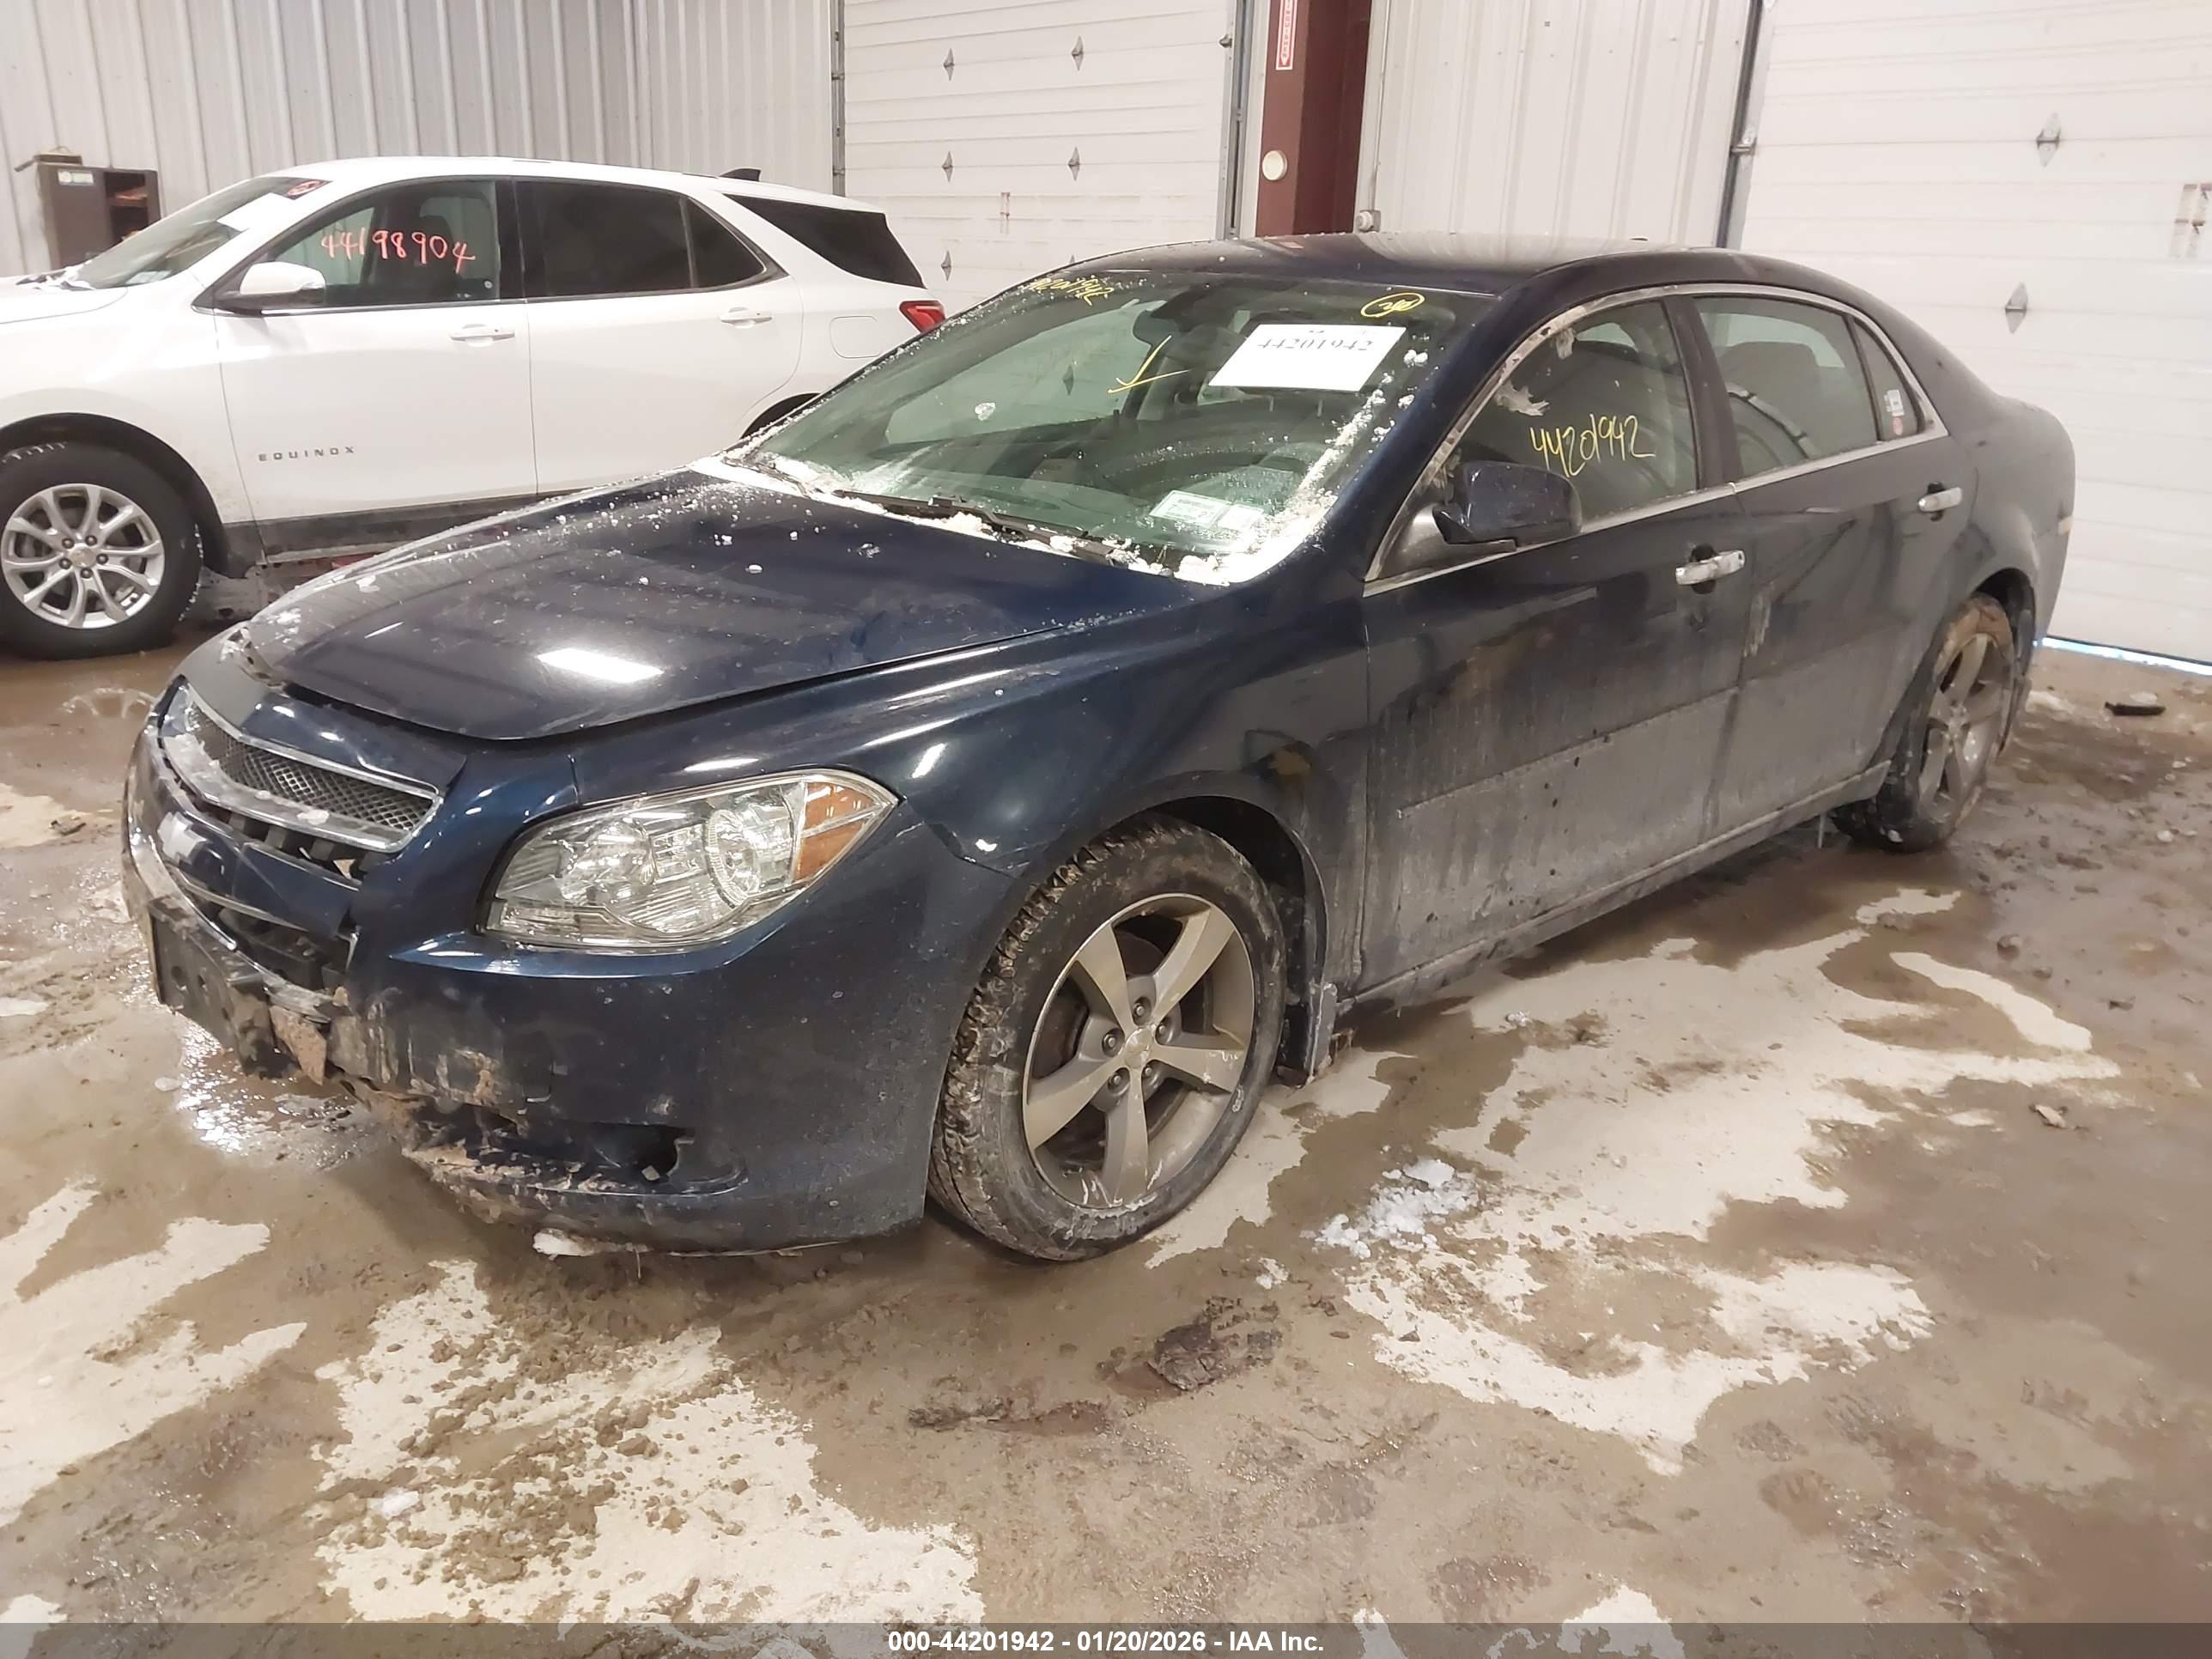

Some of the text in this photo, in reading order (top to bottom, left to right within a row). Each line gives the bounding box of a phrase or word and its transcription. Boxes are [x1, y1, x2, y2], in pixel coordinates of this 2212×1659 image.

[321, 227, 476, 274] 44198904
[1257, 337, 1374, 351] 44201942
[258, 447, 355, 462] EQUINOX
[1530, 413, 1656, 478] 44201942
